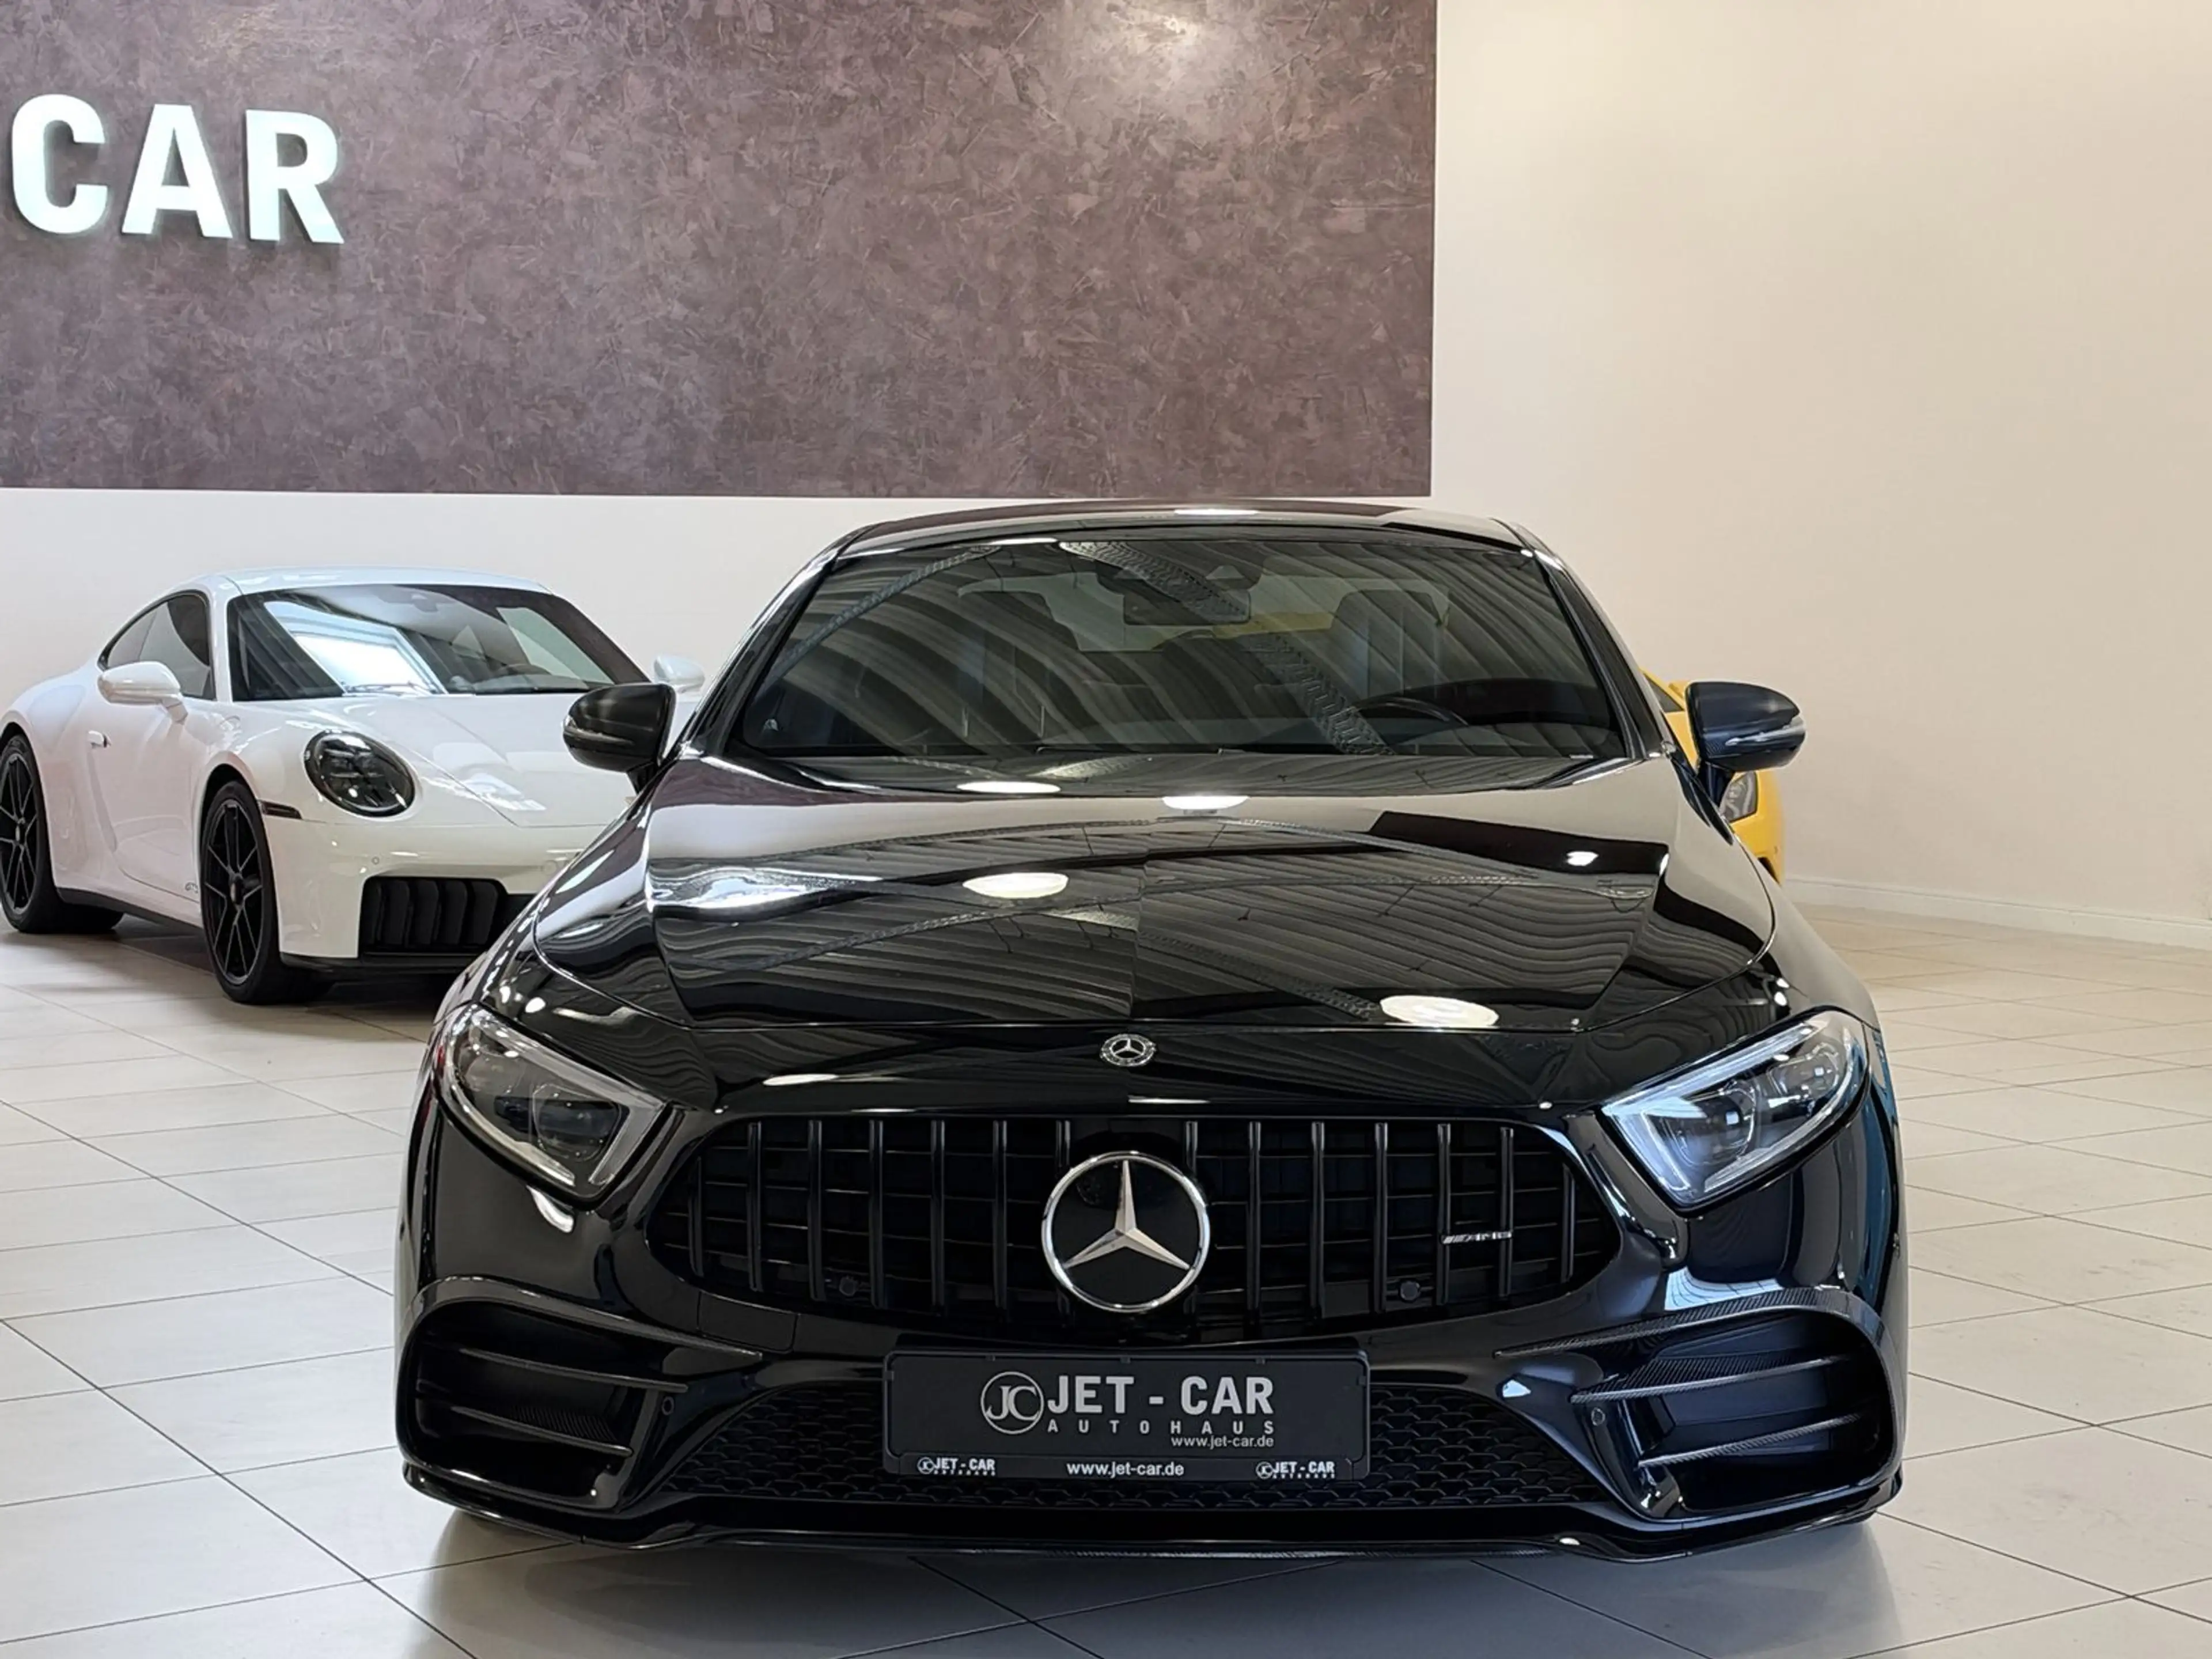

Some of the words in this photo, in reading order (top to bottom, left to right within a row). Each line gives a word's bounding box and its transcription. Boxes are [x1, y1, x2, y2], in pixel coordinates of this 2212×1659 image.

[12, 93, 344, 244] CAR
[986, 1385, 1038, 1421] JC
[1047, 1375, 1134, 1414] JET
[1181, 1376, 1274, 1415] CAR
[1171, 1435, 1274, 1450] www.jet-car.de
[934, 1457, 959, 1469] JET
[969, 1458, 995, 1471] CAR
[1067, 1461, 1184, 1479] www.jet-car.de
[1272, 1461, 1298, 1473] JET
[1309, 1461, 1335, 1474] CAR
